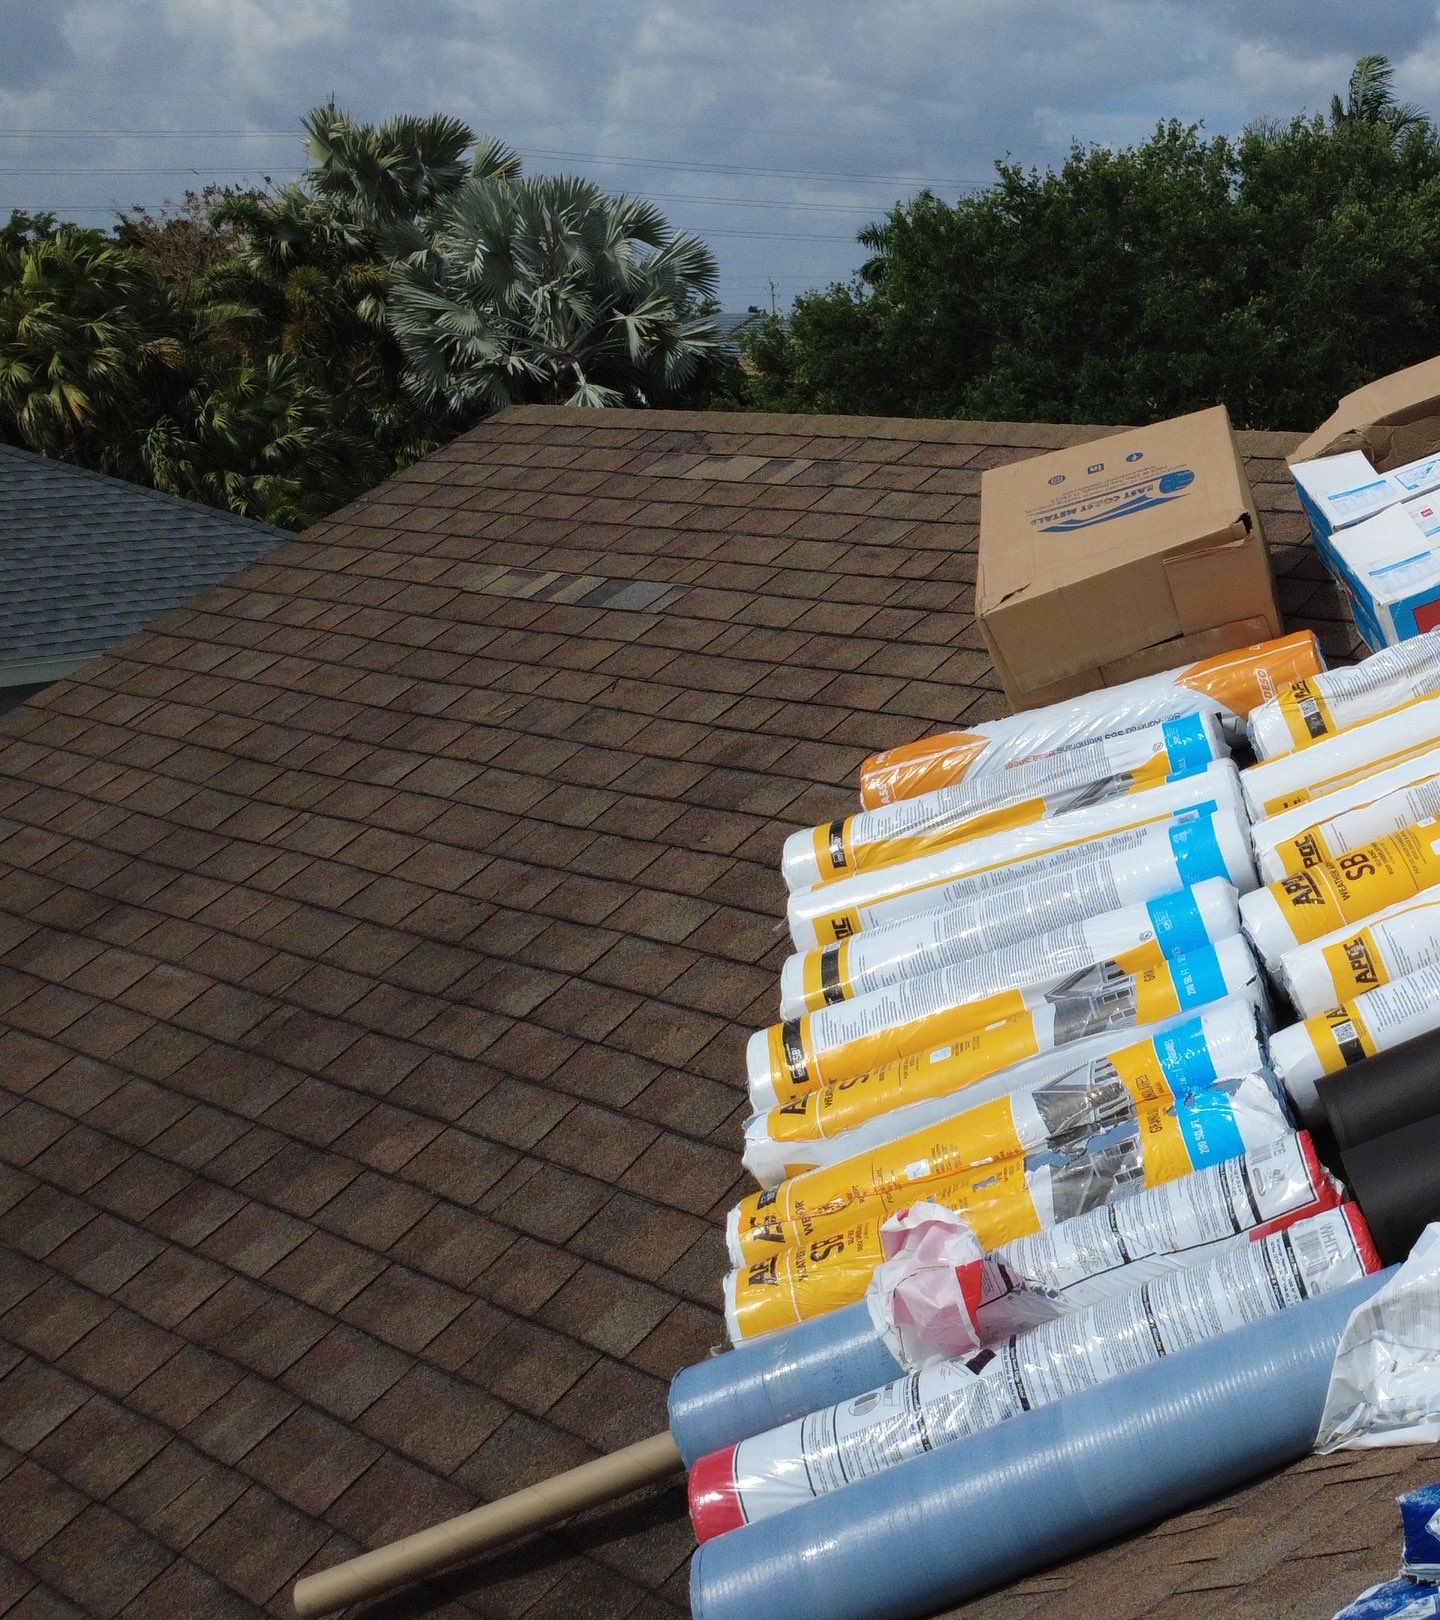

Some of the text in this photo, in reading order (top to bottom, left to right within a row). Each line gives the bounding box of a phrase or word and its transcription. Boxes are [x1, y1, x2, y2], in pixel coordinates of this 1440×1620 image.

[1081, 496, 1119, 513] COAST
[1124, 485, 1154, 499] EAST
[1294, 833, 1322, 868] POC
[1281, 871, 1325, 907] APO
[1343, 936, 1378, 983] APOC
